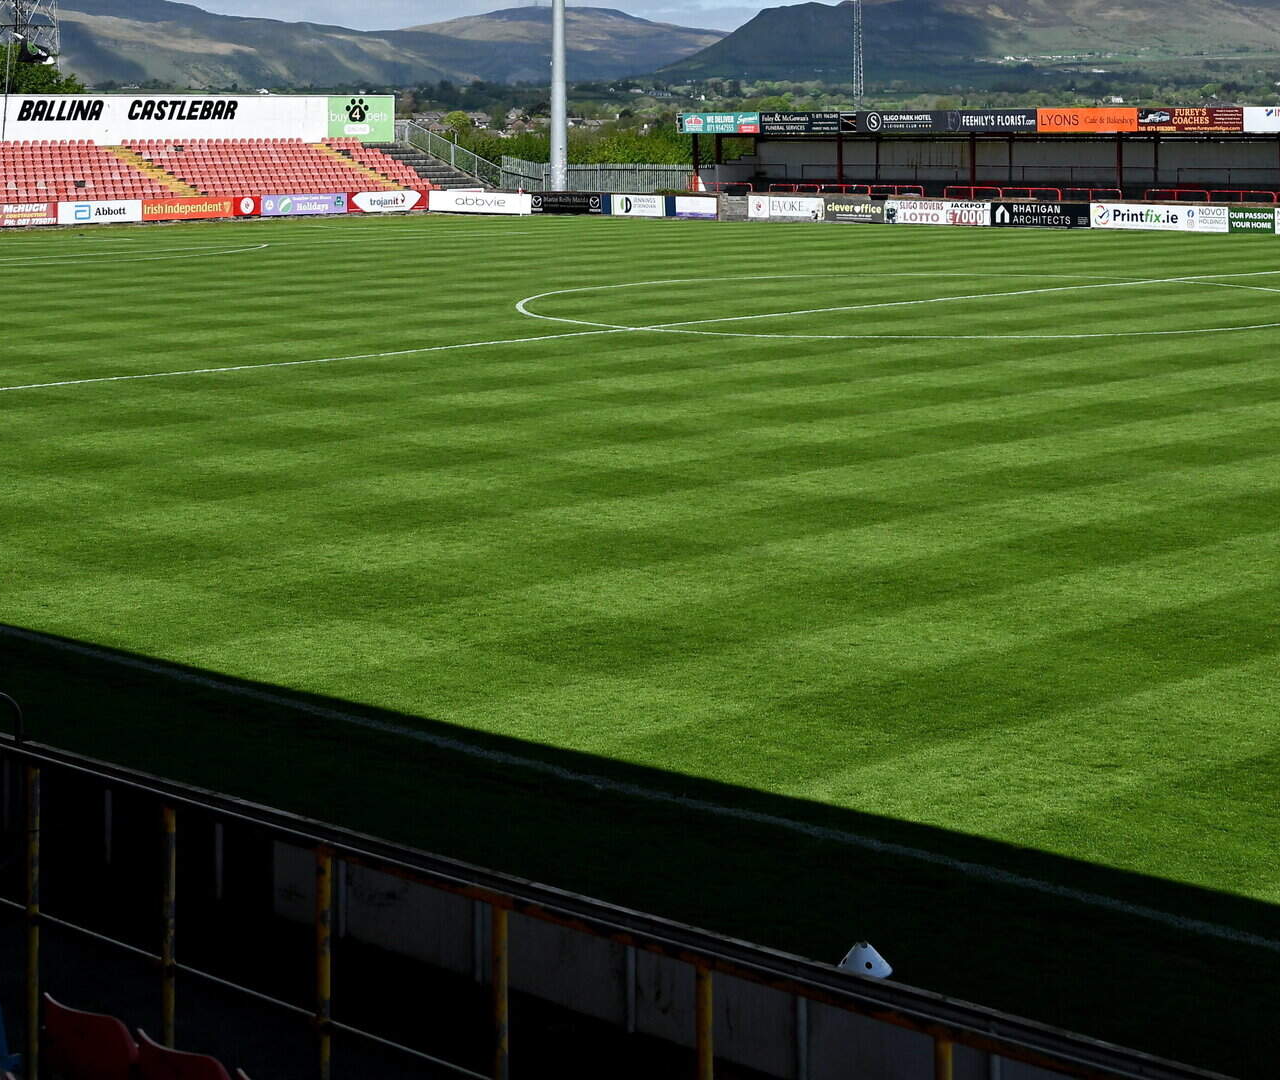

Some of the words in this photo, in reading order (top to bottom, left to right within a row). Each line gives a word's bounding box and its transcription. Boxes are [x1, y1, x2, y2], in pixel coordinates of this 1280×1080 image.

[16, 99, 105, 122] BALLINA
[127, 99, 239, 121] CASTLEBAR
[1174, 108, 1207, 116] FUREY'S
[962, 115, 995, 127] FEEHILY'S
[997, 115, 1036, 126] FLORIST.com
[1040, 114, 1079, 126] LYONS
[1172, 116, 1210, 125] COACHES
[296, 201, 329, 211] Holidays
[454, 196, 506, 207] abbvie
[771, 200, 803, 212] EVOKE
[899, 202, 918, 210] SLIGO
[920, 202, 944, 211] ROVERS
[3, 203, 48, 213] McHUGH
[94, 205, 127, 217] Abbott
[143, 202, 164, 216] Irish
[164, 201, 222, 215] Independent
[1012, 204, 1061, 214] RHATIGAN
[1198, 207, 1226, 217] NOVOT
[903, 213, 940, 223] LOTTO
[1012, 214, 1071, 225] ARCHITECTS
[1112, 208, 1179, 225] Printfix.ie
[1229, 211, 1244, 220] OUR
[1245, 211, 1274, 220] PASSION
[1198, 218, 1227, 226] HOLDINGS
[1231, 220, 1250, 229] YOUR
[1251, 220, 1272, 229] HOME
